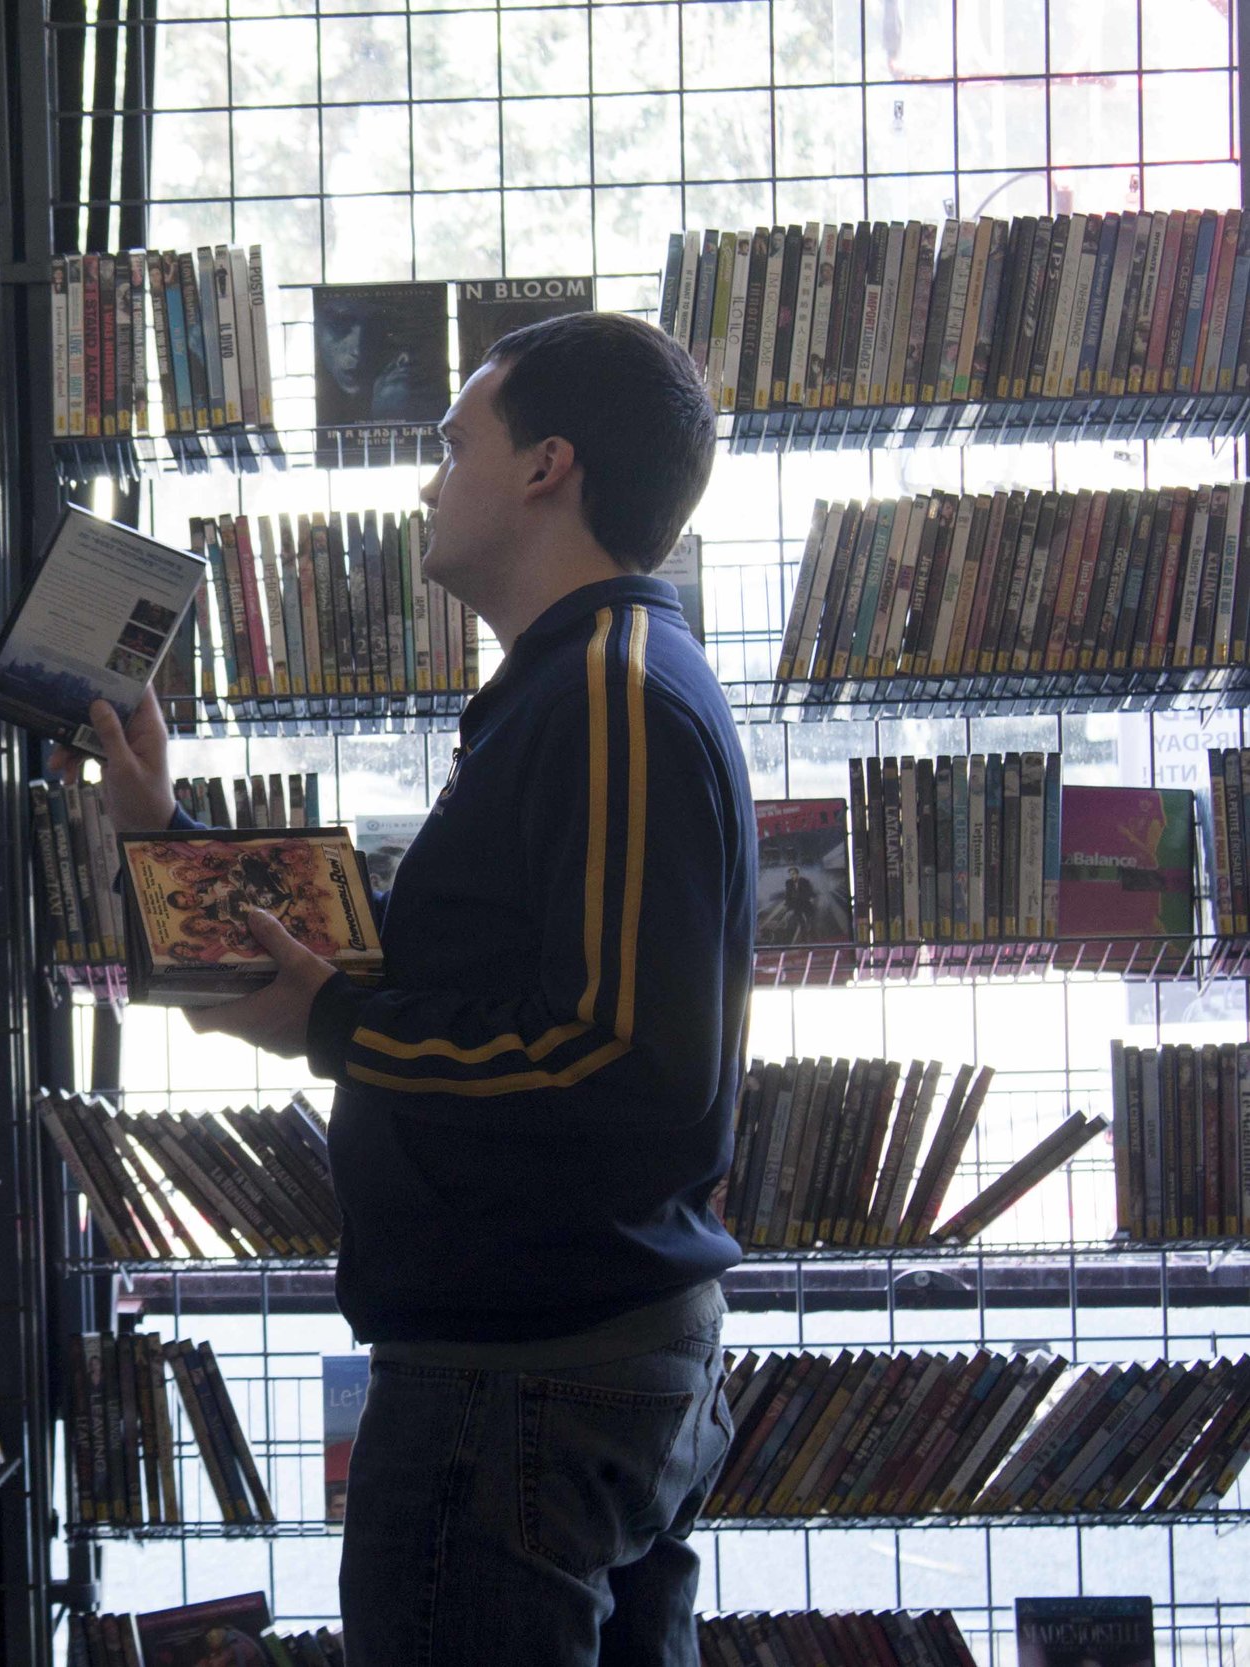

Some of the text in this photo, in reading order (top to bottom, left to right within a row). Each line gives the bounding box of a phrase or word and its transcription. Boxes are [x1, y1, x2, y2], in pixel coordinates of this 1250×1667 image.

[1148, 231, 1160, 273] INTIMATE
[250, 252, 264, 306] IL POSTO
[495, 279, 586, 300] BLOOM
[683, 281, 693, 300] WANT
[1178, 266, 1191, 296] DUST
[1190, 273, 1207, 310] WORLD
[86, 300, 97, 348] STAND
[682, 302, 692, 310] TO
[865, 291, 878, 331] IMPORT
[1070, 283, 1088, 348] INHERITANCE
[1212, 276, 1228, 338] INDOCHINE
[70, 333, 81, 355] LOVE
[221, 323, 234, 359] IL DIVO
[761, 332, 773, 368] HOME
[1167, 329, 1181, 366] STARS
[87, 355, 97, 402] ALONE
[264, 563, 280, 627] IPHIGENIA
[878, 557, 897, 614] JERICHOW
[1073, 559, 1094, 617] Junk Food
[1107, 547, 1124, 609] LOVE STORY
[1201, 552, 1220, 609] KALIMAN
[465, 606, 478, 649] LOUSY
[358, 639, 367, 654] 2
[1227, 786, 1236, 799] LA
[1228, 800, 1239, 833] PETITE
[329, 859, 347, 886] RUN
[1062, 852, 1138, 867] aBalance
[47, 882, 63, 917] TAXI
[338, 882, 367, 952] CANNONBALL
[330, 1383, 364, 1408] Let
[89, 1393, 107, 1473] LEAVING
